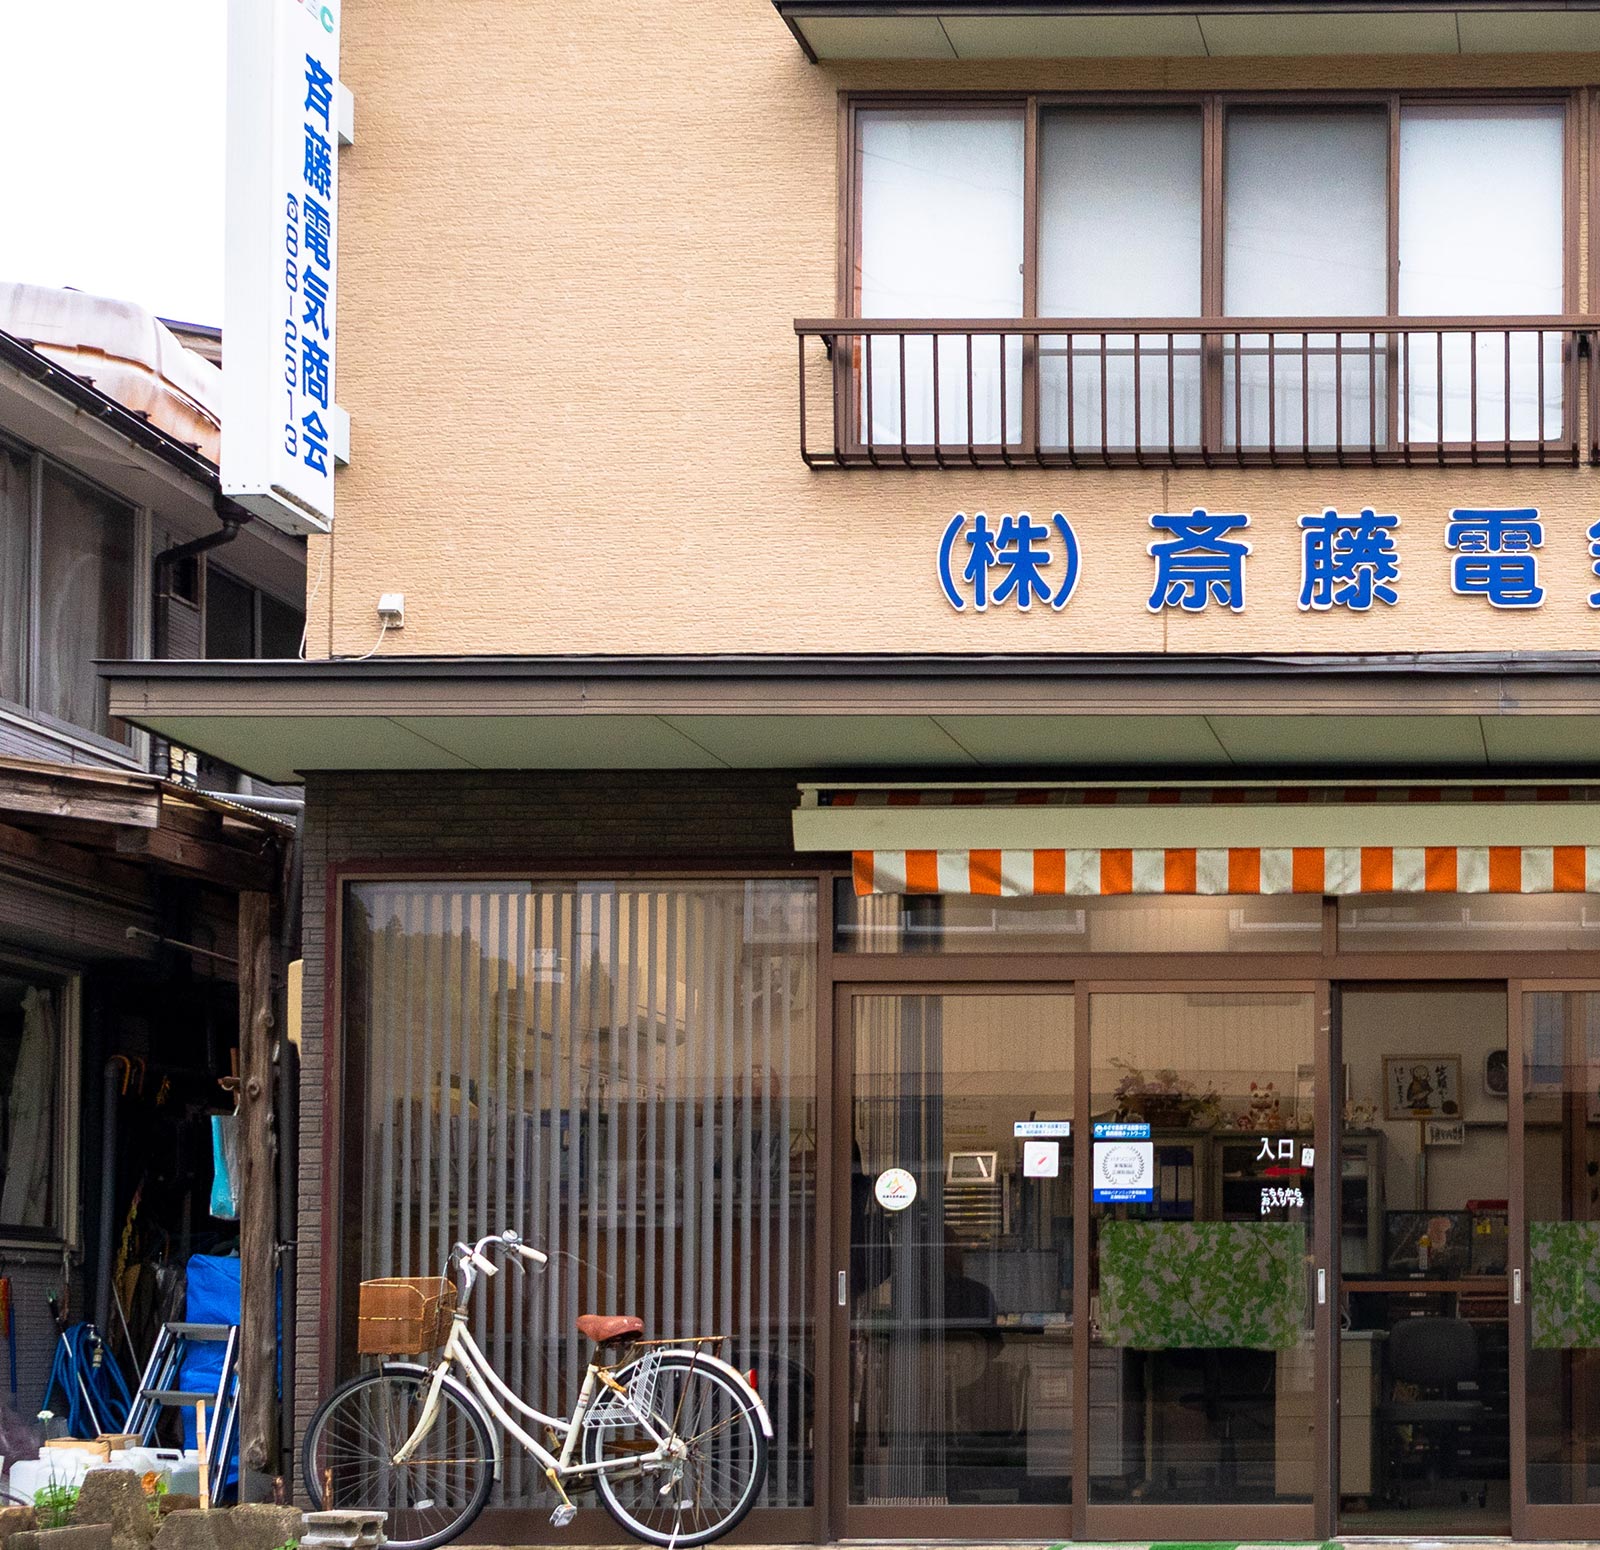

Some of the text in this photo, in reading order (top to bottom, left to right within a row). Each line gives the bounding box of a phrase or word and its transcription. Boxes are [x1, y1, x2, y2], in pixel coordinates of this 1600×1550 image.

[1256, 1136, 1294, 1161] 入口
[1261, 1187, 1302, 1197] こちらから
[1261, 1206, 1271, 1215] い
